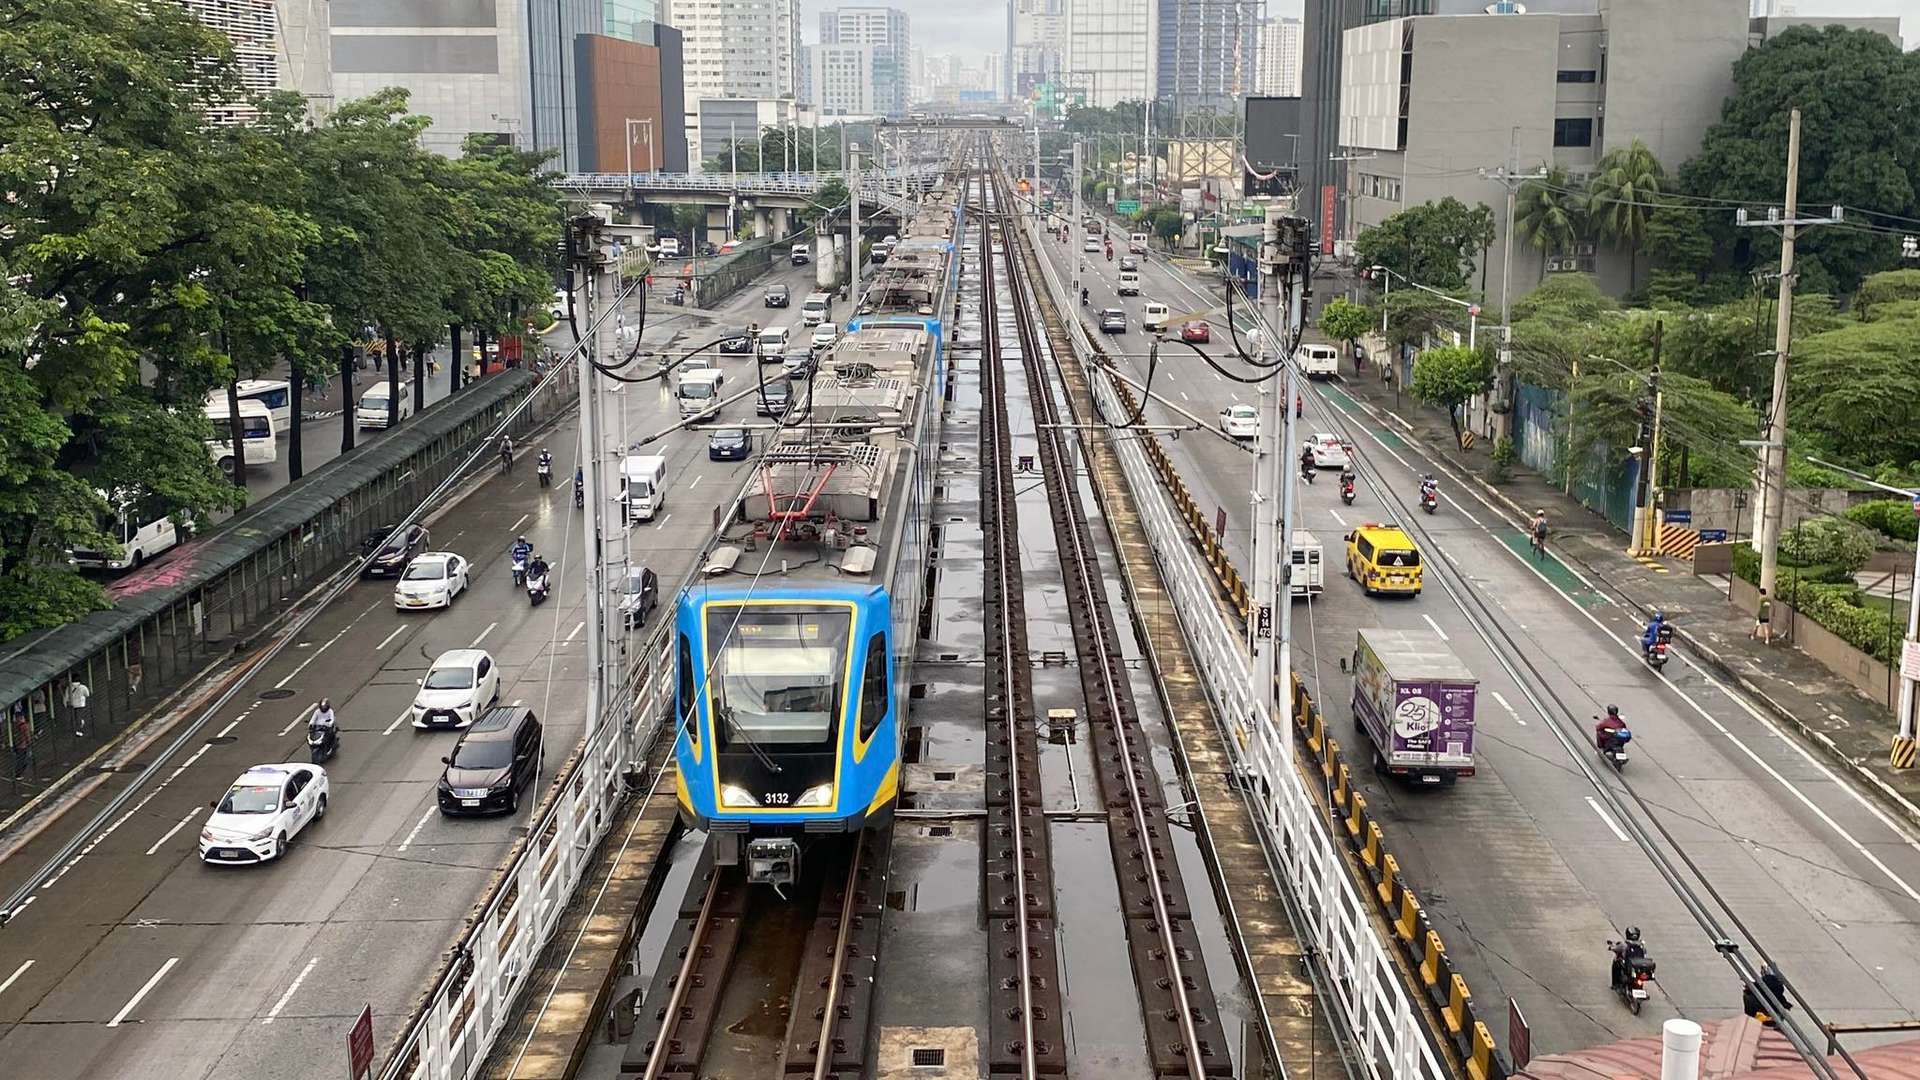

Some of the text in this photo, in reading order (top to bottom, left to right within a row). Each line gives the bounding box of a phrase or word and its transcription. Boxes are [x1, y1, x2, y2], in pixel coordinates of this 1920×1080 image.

[1400, 702, 1426, 721] 25
[1407, 721, 1426, 731] Klio
[765, 792, 789, 804] 3132
